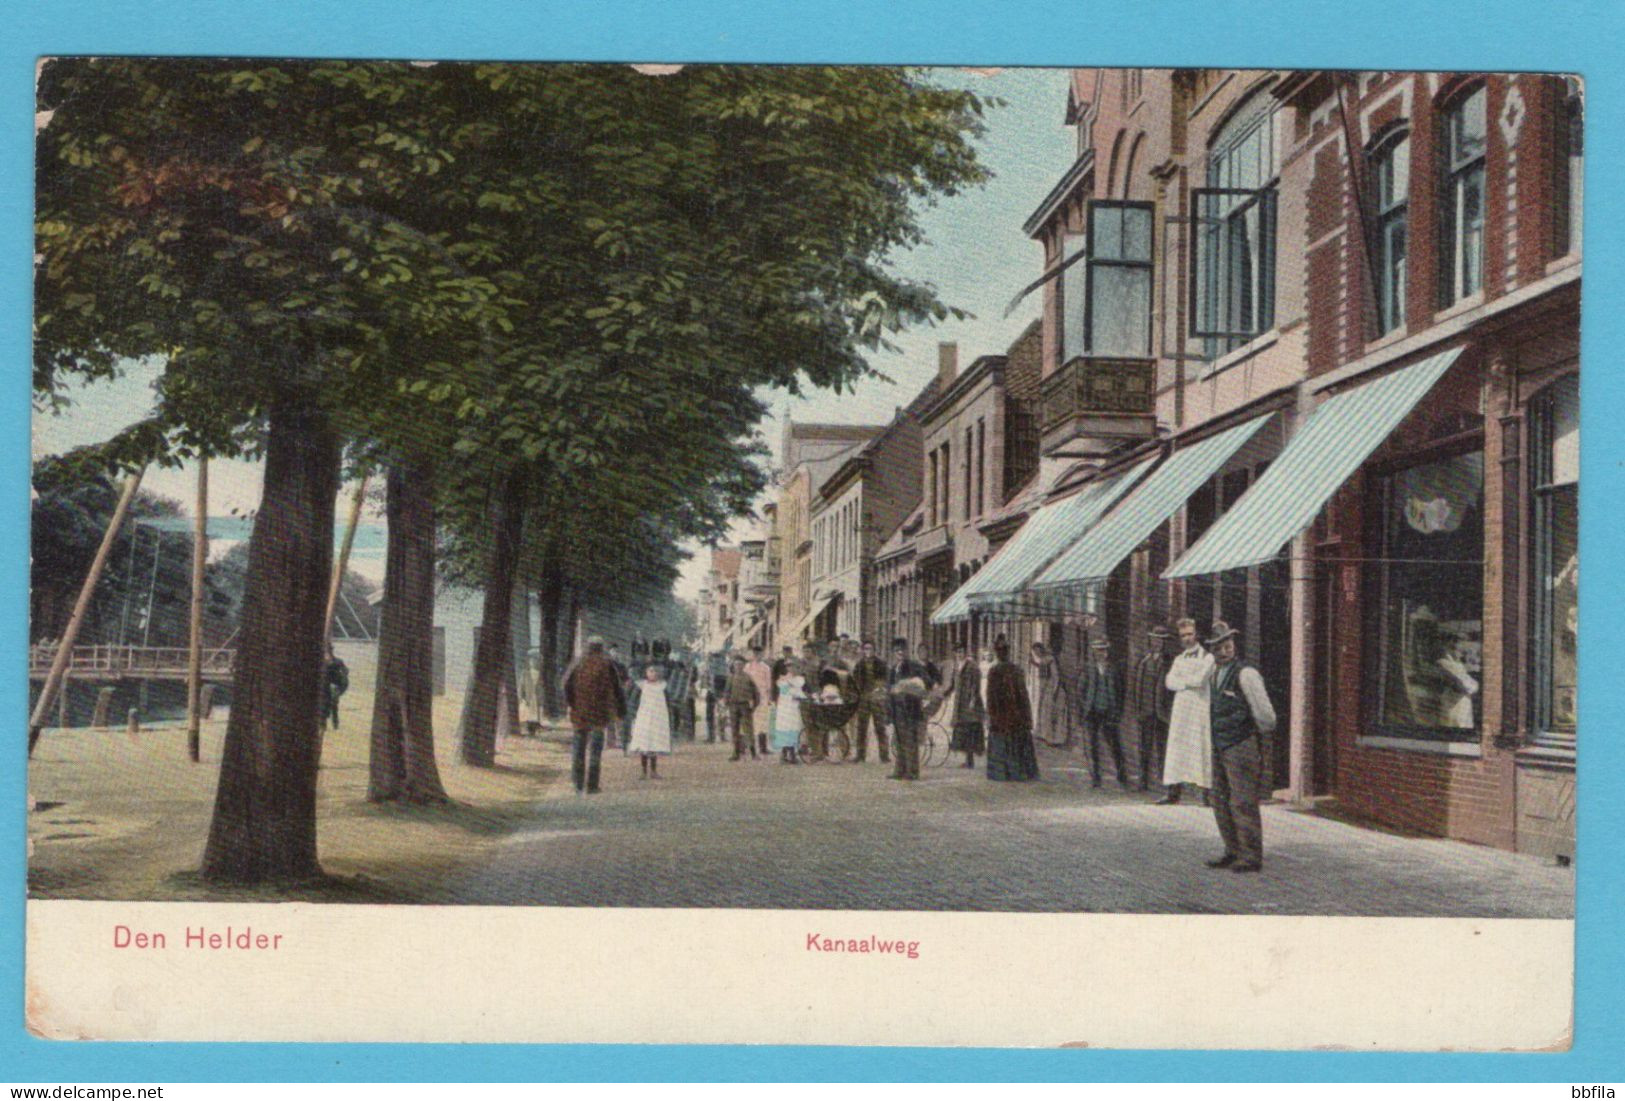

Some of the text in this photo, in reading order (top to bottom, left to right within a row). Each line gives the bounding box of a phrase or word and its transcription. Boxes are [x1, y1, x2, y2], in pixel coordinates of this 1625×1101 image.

[113, 925, 283, 949] Den Helder
[806, 933, 919, 959] Kanaalweg
